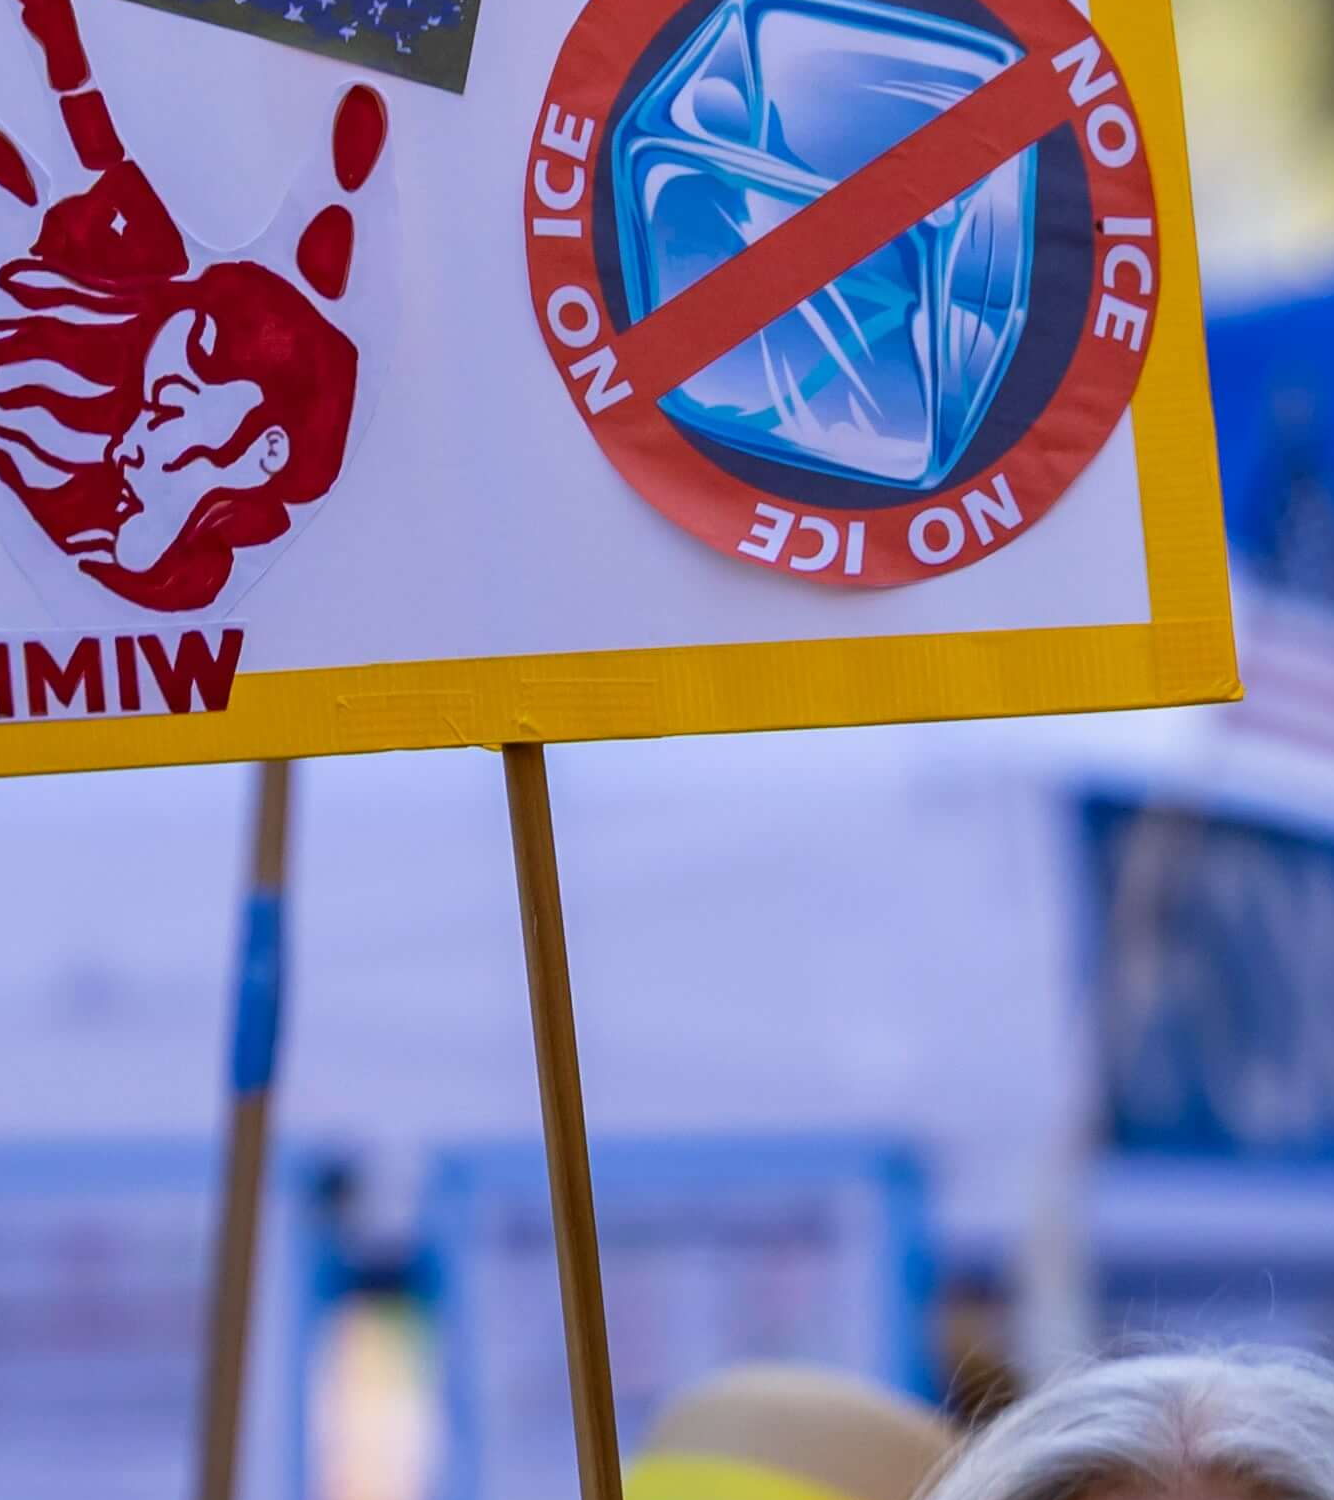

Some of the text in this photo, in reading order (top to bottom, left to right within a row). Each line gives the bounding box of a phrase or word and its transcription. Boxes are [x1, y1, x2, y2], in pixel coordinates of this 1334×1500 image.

[533, 103, 633, 415] NO ICE
[1052, 35, 1153, 352] NO ICE
[737, 473, 1023, 575] NO ICE
